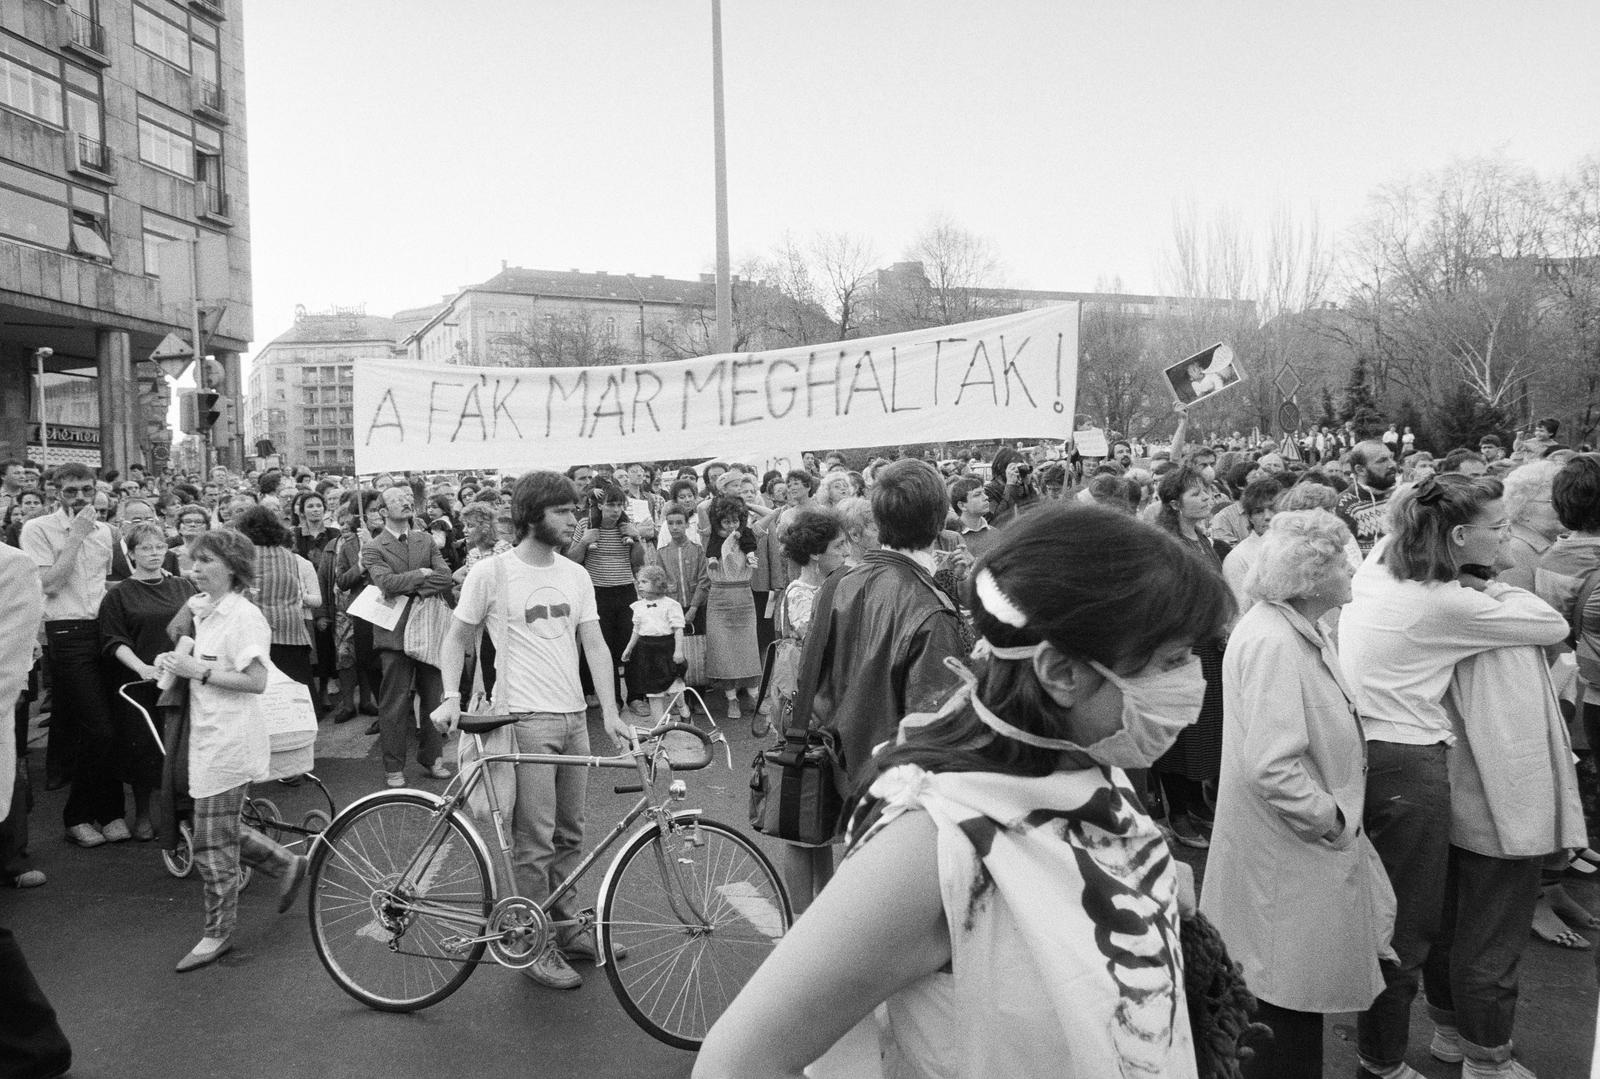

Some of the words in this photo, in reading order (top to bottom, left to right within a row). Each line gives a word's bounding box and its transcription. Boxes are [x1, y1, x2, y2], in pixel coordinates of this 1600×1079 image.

[365, 387, 404, 446] A
[427, 373, 523, 445] FÁK
[544, 366, 661, 438] MÁR
[681, 332, 1065, 430] MEGHALTAK!
